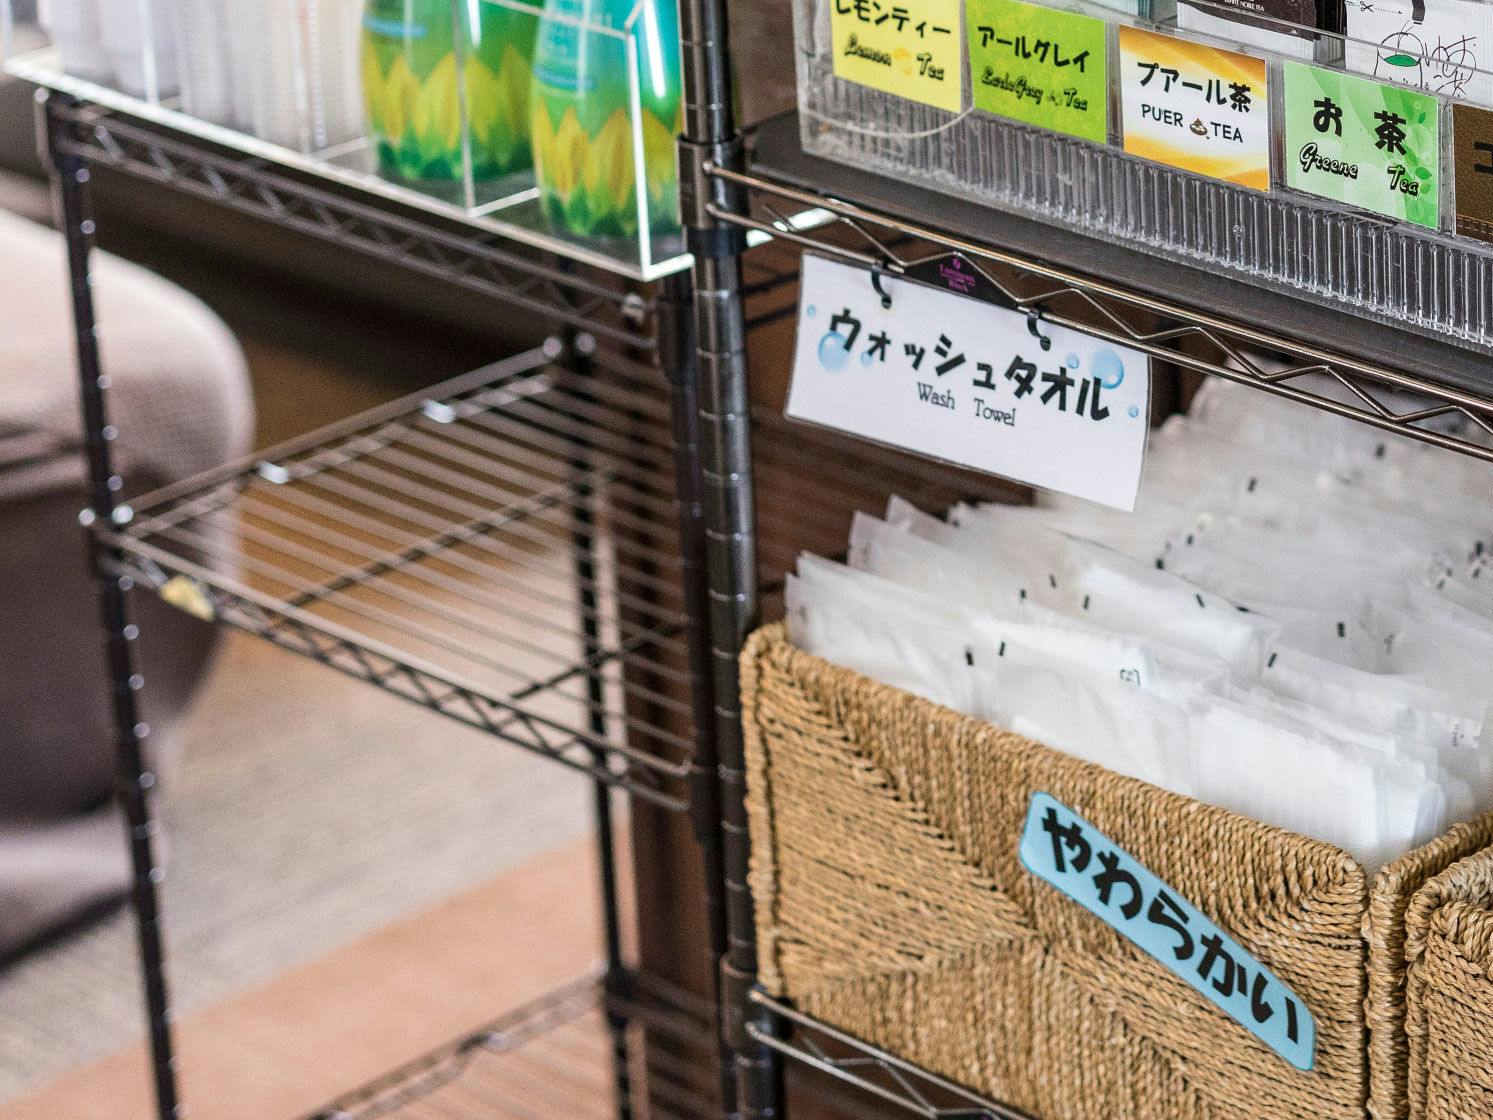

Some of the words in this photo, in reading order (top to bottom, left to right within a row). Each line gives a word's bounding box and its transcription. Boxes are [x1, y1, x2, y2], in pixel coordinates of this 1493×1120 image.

[1241, 0, 1257, 10] NOBLE
[1257, 4, 1265, 12] TEA
[916, 51, 945, 81] Tea
[977, 25, 1090, 73] アールグレイ
[1063, 87, 1088, 111] Tea
[1136, 61, 1252, 114] プアール茶
[1210, 122, 1244, 144] TEA
[1299, 142, 1359, 180] Greene
[1387, 165, 1420, 197] Tea
[829, 307, 1111, 422] ウォッシュタオル
[916, 381, 956, 411] Wash
[973, 397, 1016, 428] Towel
[1041, 806, 1299, 1046] やわらかい
